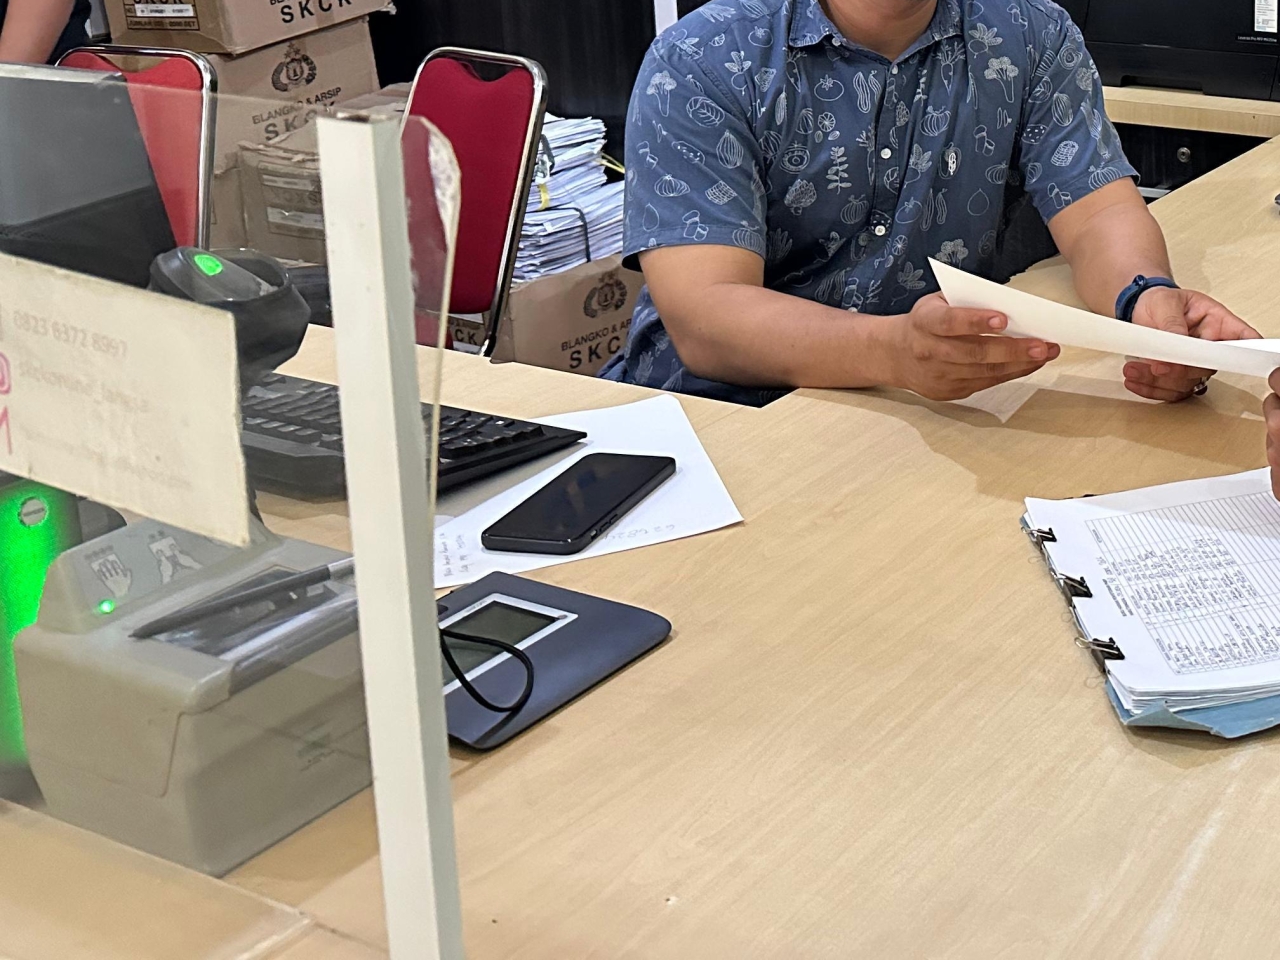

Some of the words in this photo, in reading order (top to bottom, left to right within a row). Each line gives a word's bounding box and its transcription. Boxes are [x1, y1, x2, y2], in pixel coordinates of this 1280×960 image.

[315, 87, 341, 104] ARSIP
[561, 326, 610, 351] BLANGKO
[569, 336, 621, 370] SKC
